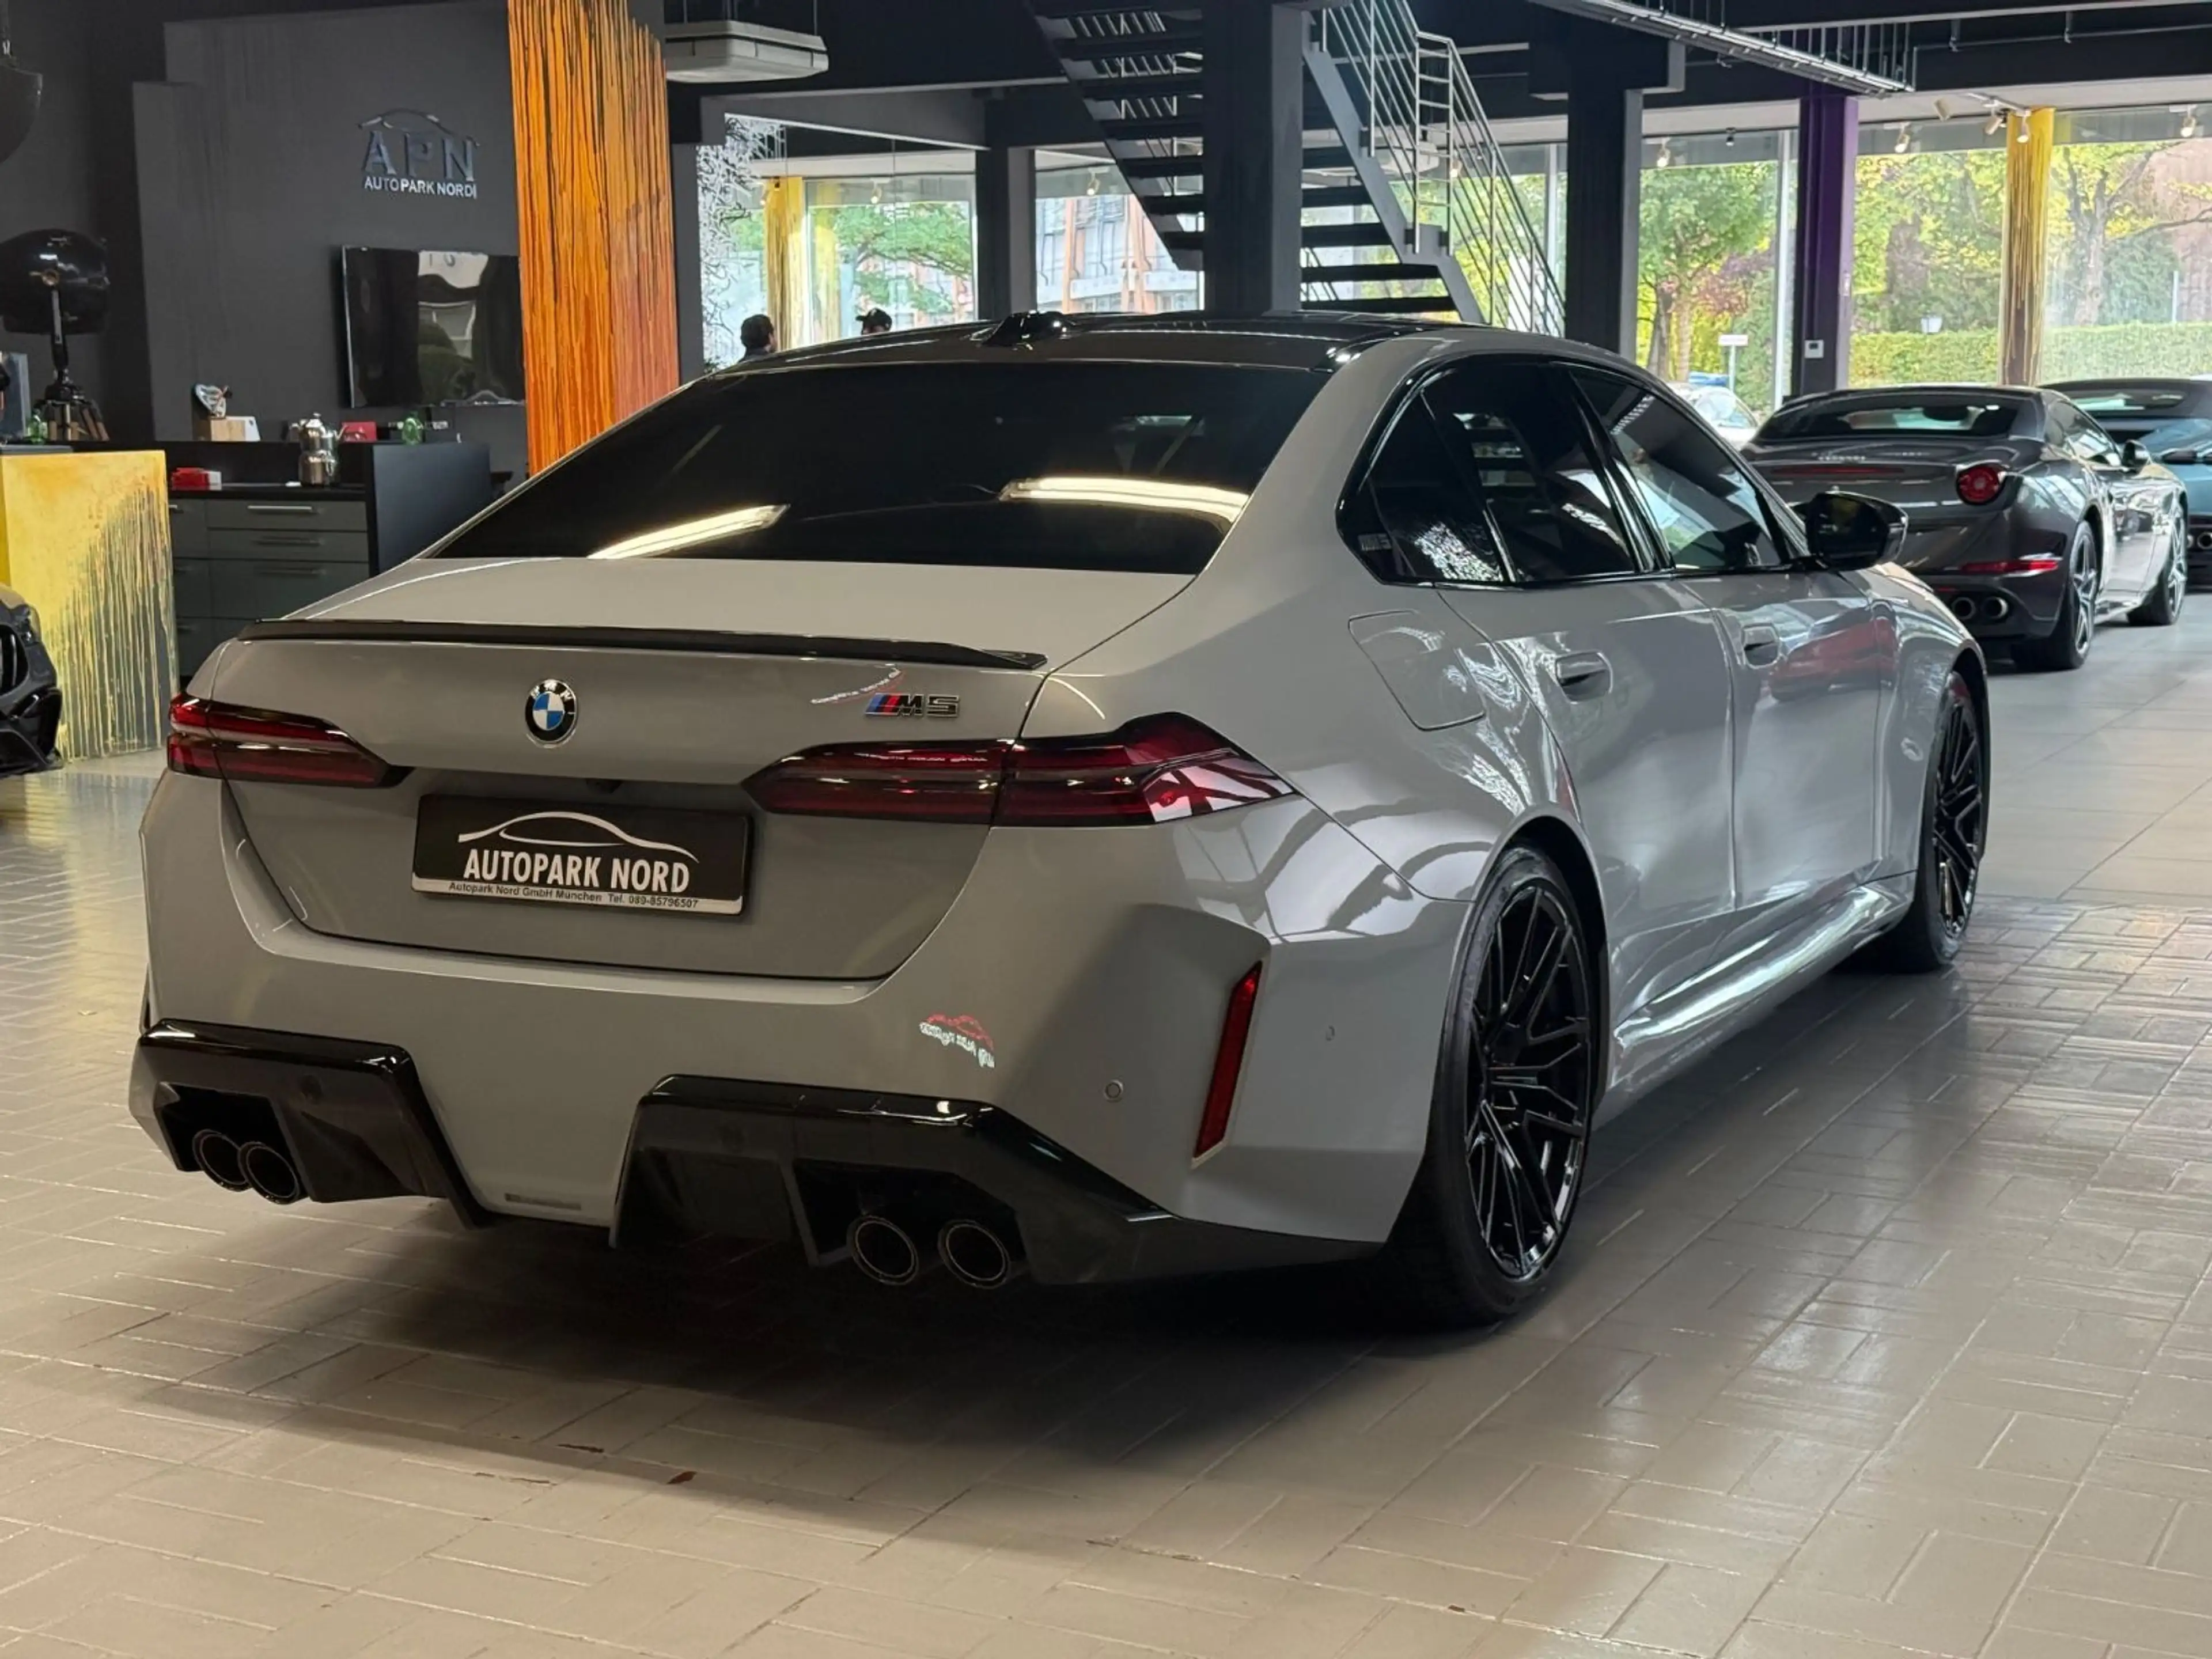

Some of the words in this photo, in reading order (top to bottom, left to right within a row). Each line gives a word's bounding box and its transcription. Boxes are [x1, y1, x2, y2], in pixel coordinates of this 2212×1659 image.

[362, 131, 474, 182] APN
[437, 183, 477, 199] NORD
[865, 692, 960, 718] M5
[463, 849, 601, 887] AUTOPARK
[611, 858, 690, 893] NORD
[449, 882, 494, 894] Autopark
[497, 886, 519, 896] Nord
[522, 888, 553, 897] GmbH
[608, 893, 625, 903] Tel.
[628, 895, 699, 908] 089-85796507
